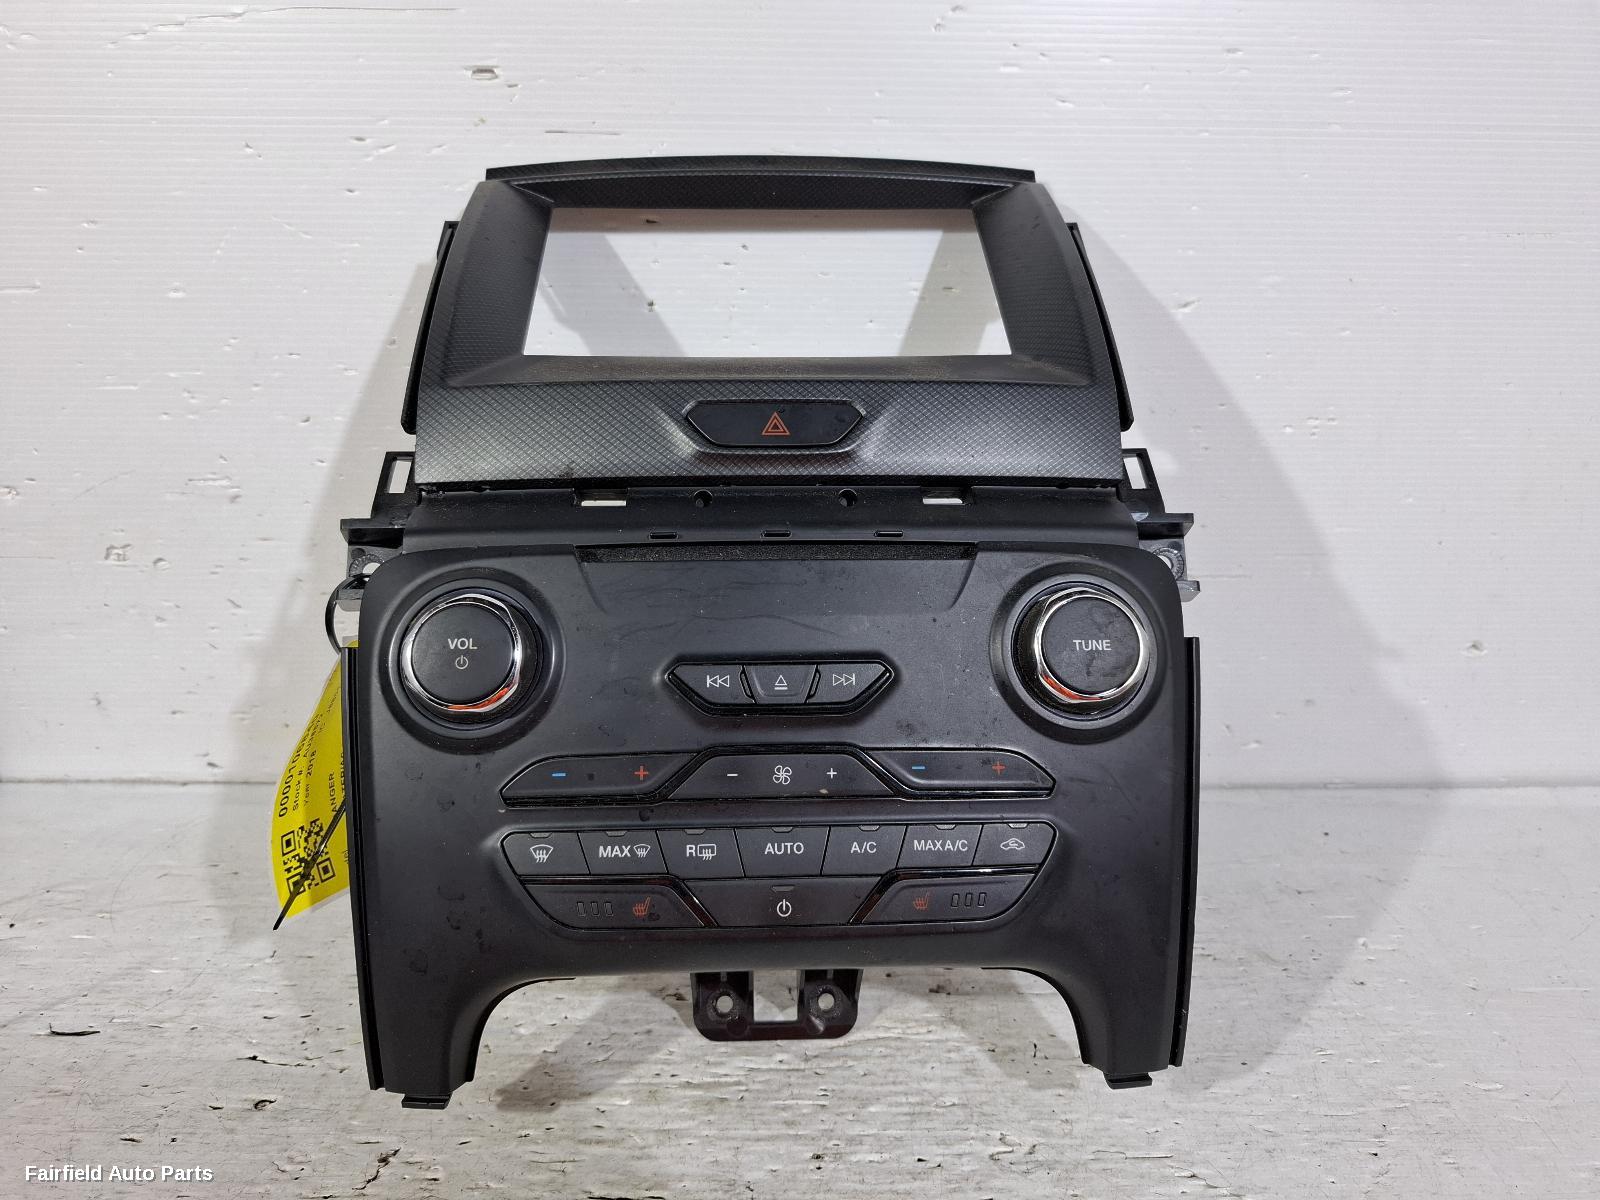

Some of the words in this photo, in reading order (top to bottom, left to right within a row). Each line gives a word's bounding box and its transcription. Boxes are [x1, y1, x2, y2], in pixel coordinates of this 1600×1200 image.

[447, 638, 478, 650] VOL
[1072, 639, 1113, 651] TUNE
[328, 771, 338, 813] ANGER
[598, 844, 632, 858] MAX
[685, 844, 696, 858] R
[764, 842, 805, 855] AUTO
[850, 841, 877, 854] A/C
